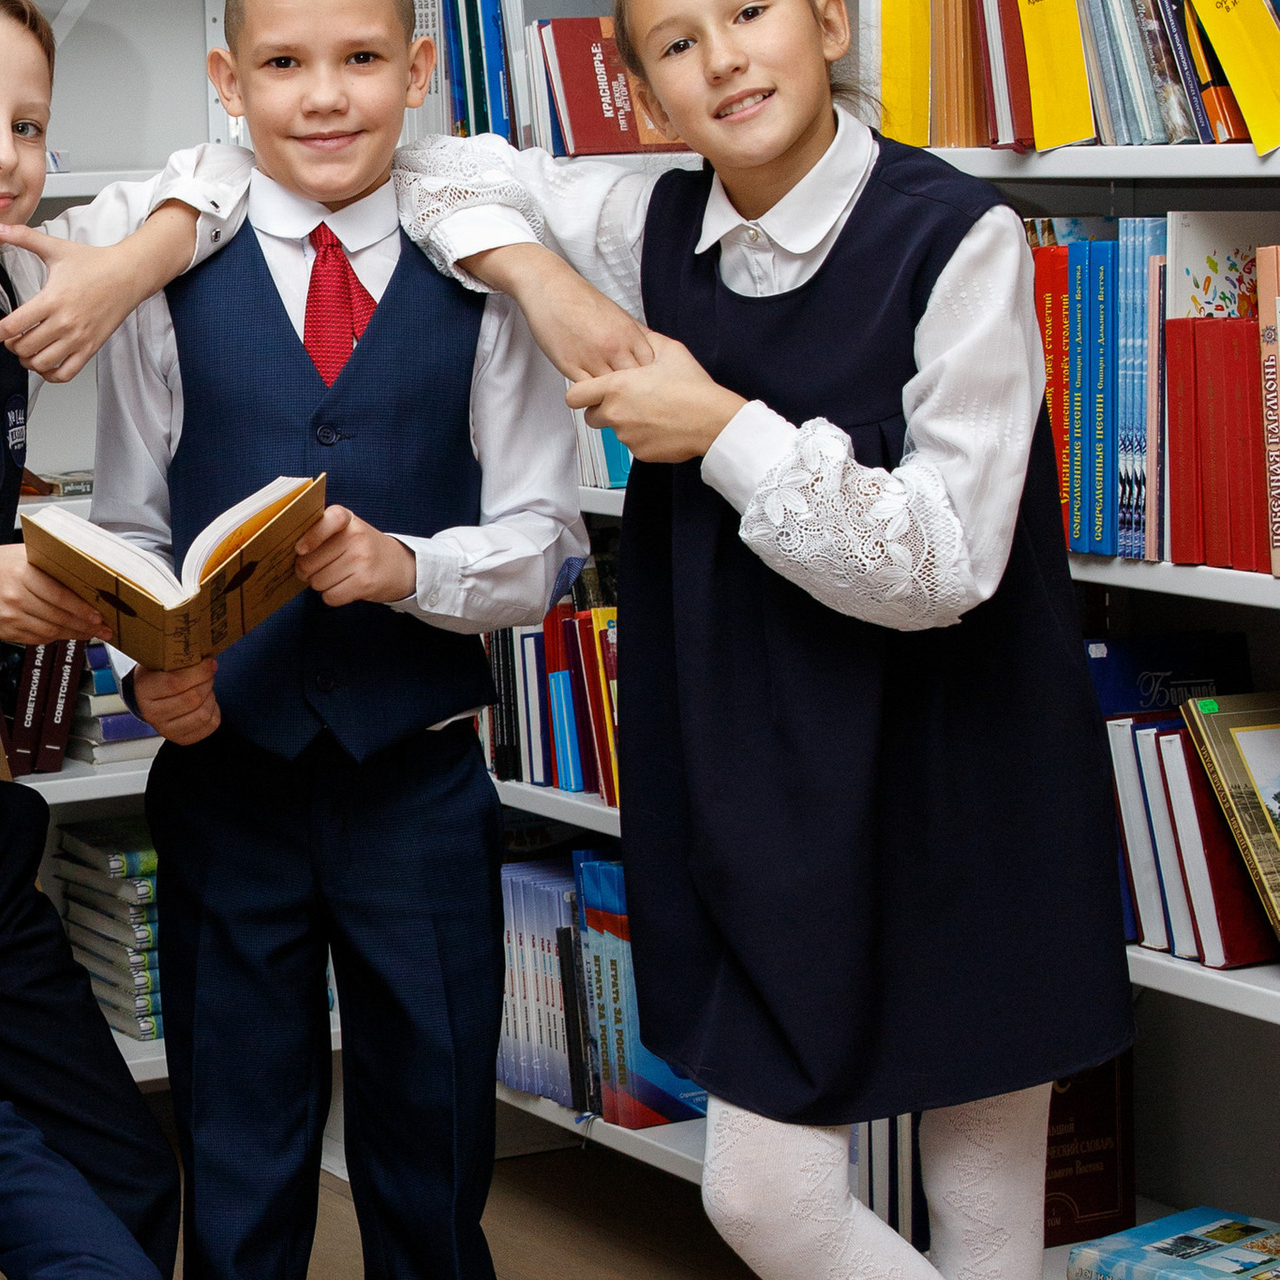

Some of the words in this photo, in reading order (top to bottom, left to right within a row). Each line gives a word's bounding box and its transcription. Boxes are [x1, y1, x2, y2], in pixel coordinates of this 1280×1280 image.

[590, 41, 614, 118] КРАСНОЯРЬЕ:
[610, 80, 623, 107] ВЕКОВ
[616, 72, 632, 111] ИСТОРИИ
[617, 108, 628, 131] ПЯТЬ
[1074, 265, 1082, 299] Востока
[1073, 392, 1082, 436] ПЕСНИ
[1262, 354, 1279, 444] ГАРМОНЬ
[1072, 441, 1081, 537] СОВРЕМЕННЫЕ
[52, 664, 72, 723] СОВЕТСКИЙ
[609, 959, 620, 1004] ИГРАТЬ
[613, 1007, 622, 1024] ЗА
